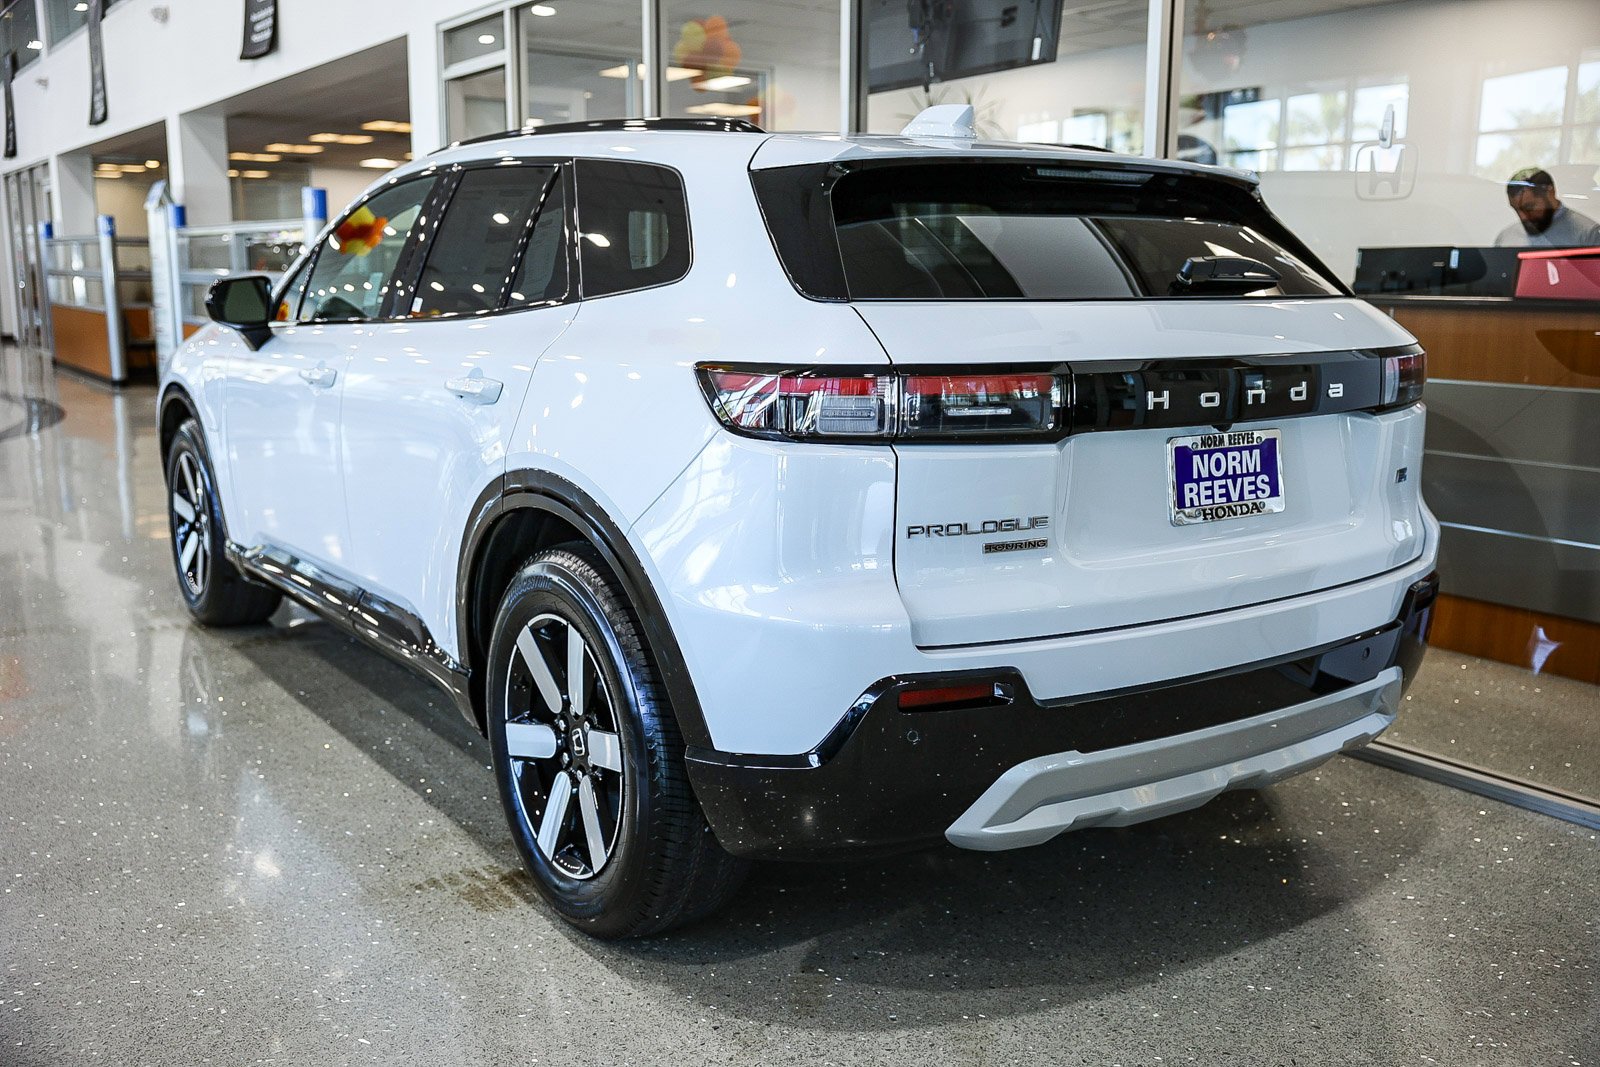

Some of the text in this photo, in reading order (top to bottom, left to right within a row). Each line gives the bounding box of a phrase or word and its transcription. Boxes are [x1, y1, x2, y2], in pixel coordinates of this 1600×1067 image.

[1147, 381, 1344, 410] Honda
[1200, 432, 1255, 449] NORM REEVES
[1192, 449, 1261, 479] NORM
[1184, 474, 1271, 508] REEVES
[1201, 502, 1262, 520] HONDA
[906, 516, 1049, 539] PROLOGUE
[984, 540, 1047, 553] TOURING
